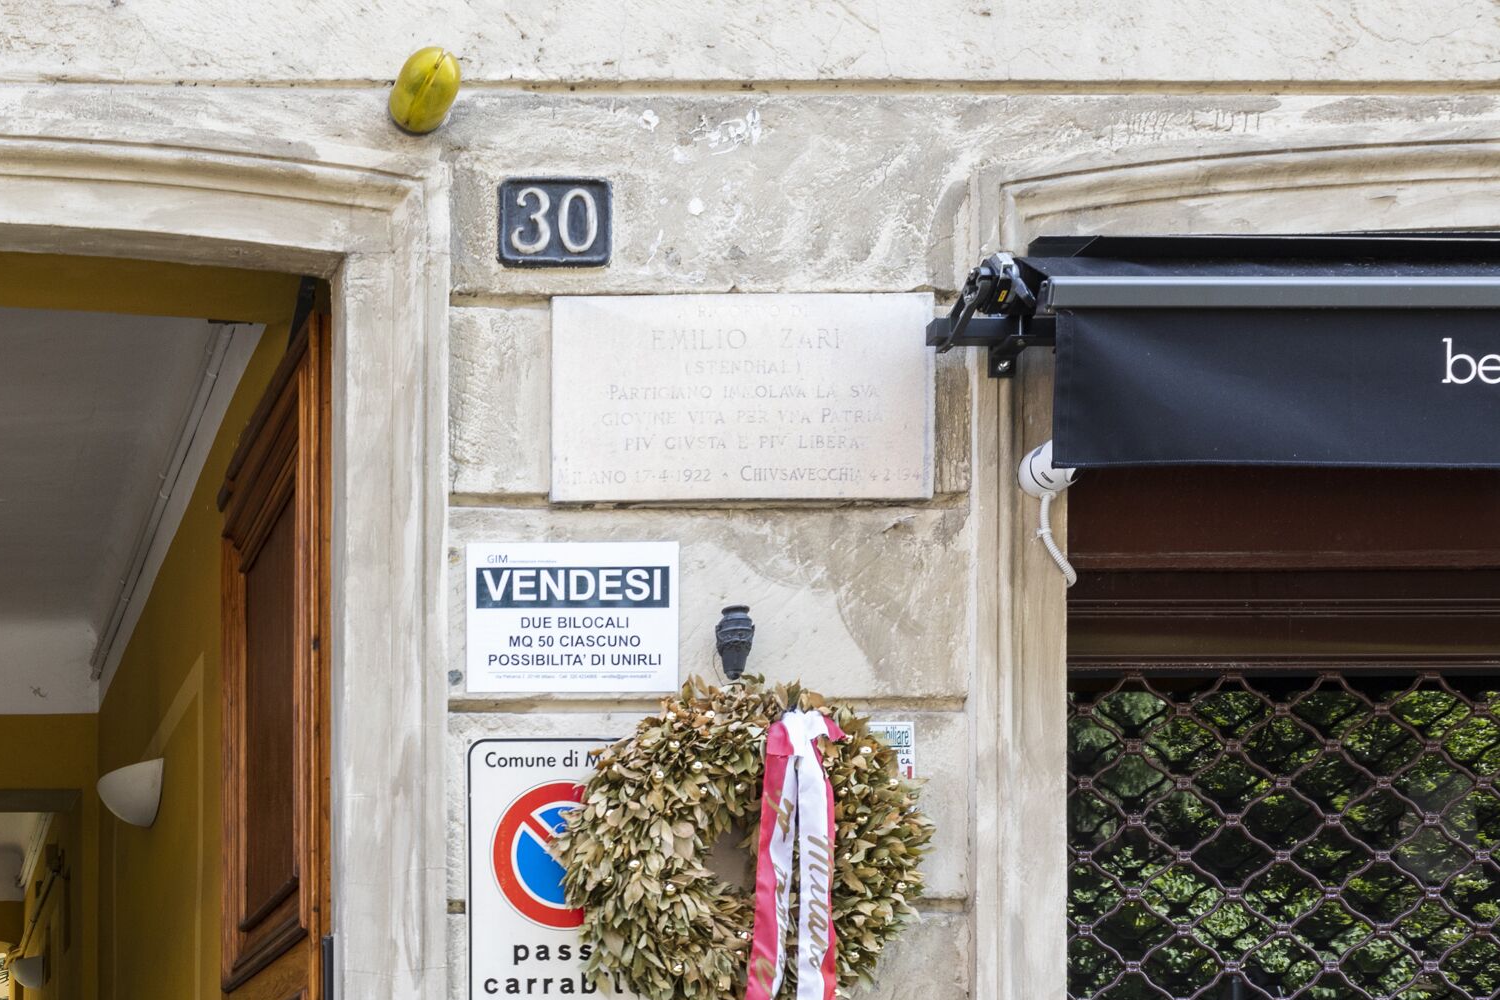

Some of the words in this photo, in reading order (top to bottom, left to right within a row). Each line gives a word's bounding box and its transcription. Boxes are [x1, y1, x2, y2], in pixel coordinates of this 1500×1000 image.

[510, 187, 598, 254] 30
[651, 328, 748, 351] EMILIO
[779, 328, 842, 350] ZARI
[1442, 337, 1500, 384] be
[608, 384, 713, 401] PARTIGIANO
[816, 383, 837, 400] LA
[687, 410, 727, 425] VITA
[736, 409, 769, 425] PER
[820, 407, 884, 425] PATRIA
[664, 434, 728, 452] GIVSTA
[798, 434, 861, 451] LIBERA
[486, 554, 509, 564] GIM
[482, 568, 663, 602] VENDESI
[520, 616, 553, 630] DUE
[557, 616, 630, 629] BILOCALI
[509, 635, 534, 649] MQ
[538, 635, 555, 648] 50
[559, 635, 642, 648] CIASCUNO
[590, 653, 606, 666] DI
[611, 653, 663, 666] UNIRLI
[484, 751, 559, 770] Comune
[562, 750, 579, 769] di
[806, 834, 838, 970] Milano
[513, 943, 593, 965] pass
[484, 971, 638, 995] carrabl
